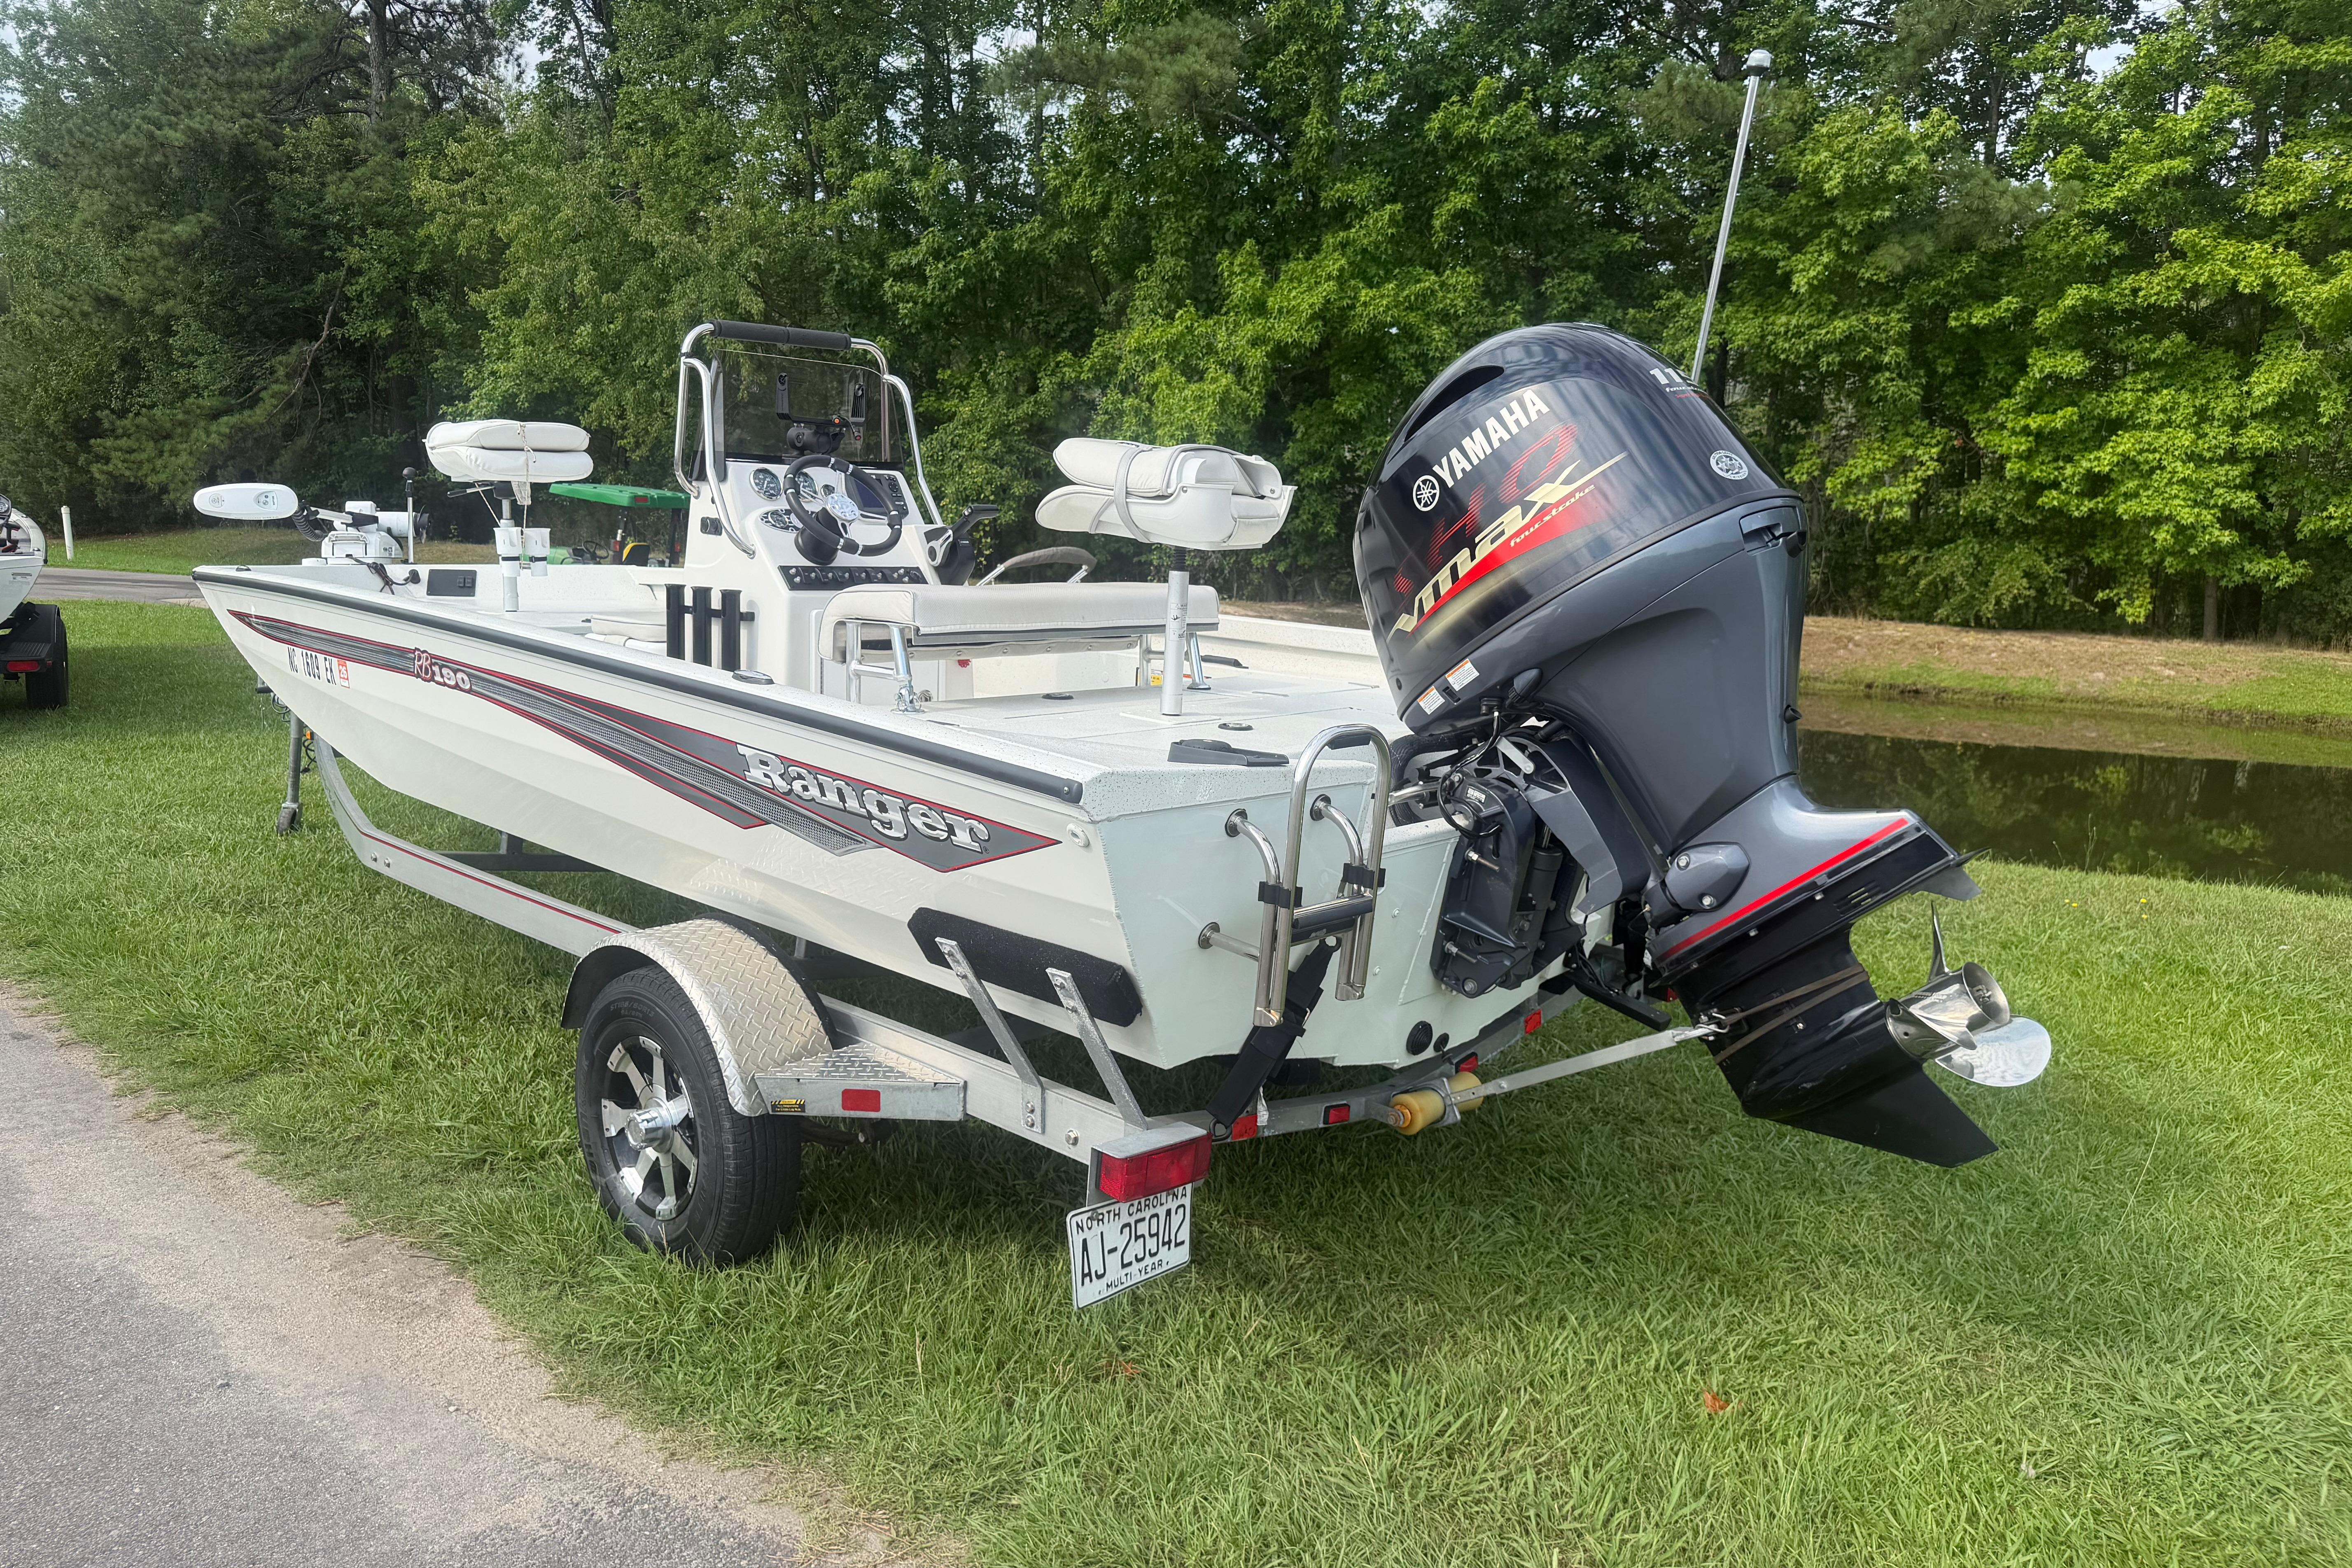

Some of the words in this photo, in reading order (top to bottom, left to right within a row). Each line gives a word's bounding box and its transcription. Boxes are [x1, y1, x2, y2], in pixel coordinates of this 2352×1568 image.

[1432, 390, 1550, 488] YAMAHA
[287, 646, 298, 673] NC
[301, 651, 320, 680] 1609
[324, 657, 336, 685] EK
[339, 665, 347, 679] 26
[737, 744, 989, 853] Ranger
[1076, 1207, 1121, 1234] NORTH
[1127, 1186, 1187, 1216] CAROLINA
[1081, 1203, 1186, 1286] AJ-25942
